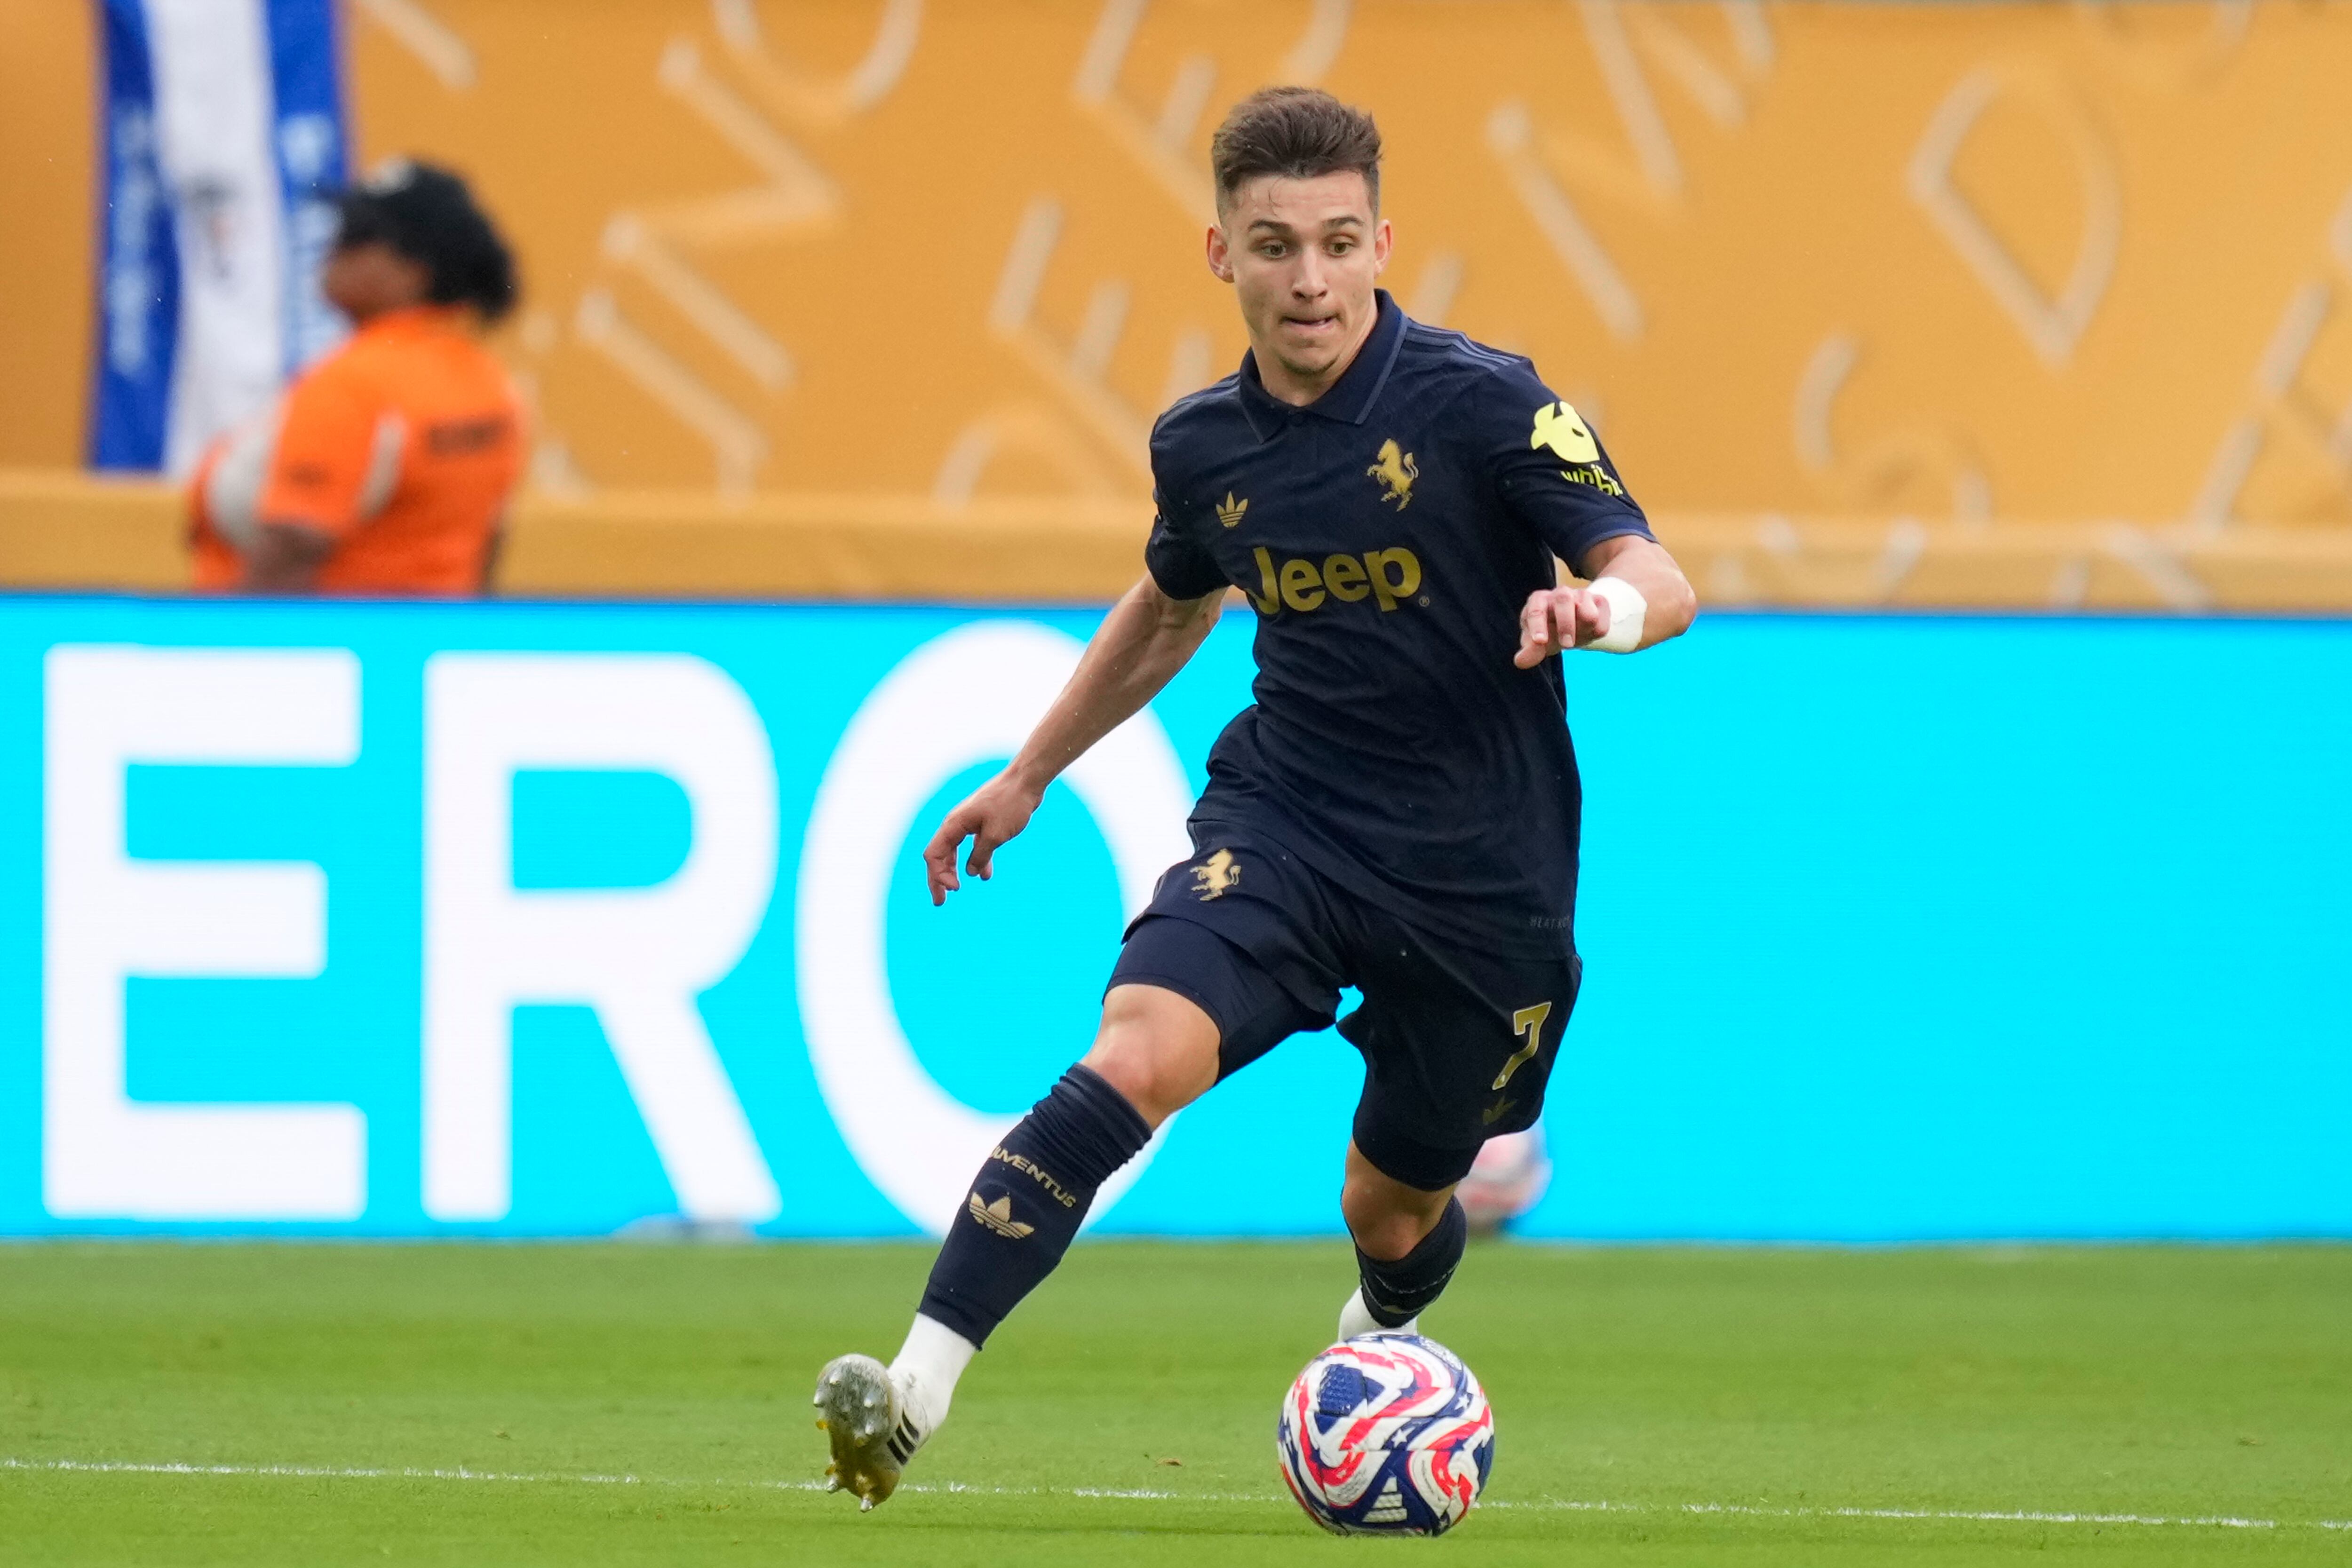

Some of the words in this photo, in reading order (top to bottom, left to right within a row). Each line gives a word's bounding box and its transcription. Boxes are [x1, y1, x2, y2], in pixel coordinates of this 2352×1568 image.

[1243, 546, 1422, 615] Jeep
[42, 623, 1199, 1241] ERO
[1492, 1002, 1552, 1091] 7
[991, 1145, 1076, 1208] UVENTUS
